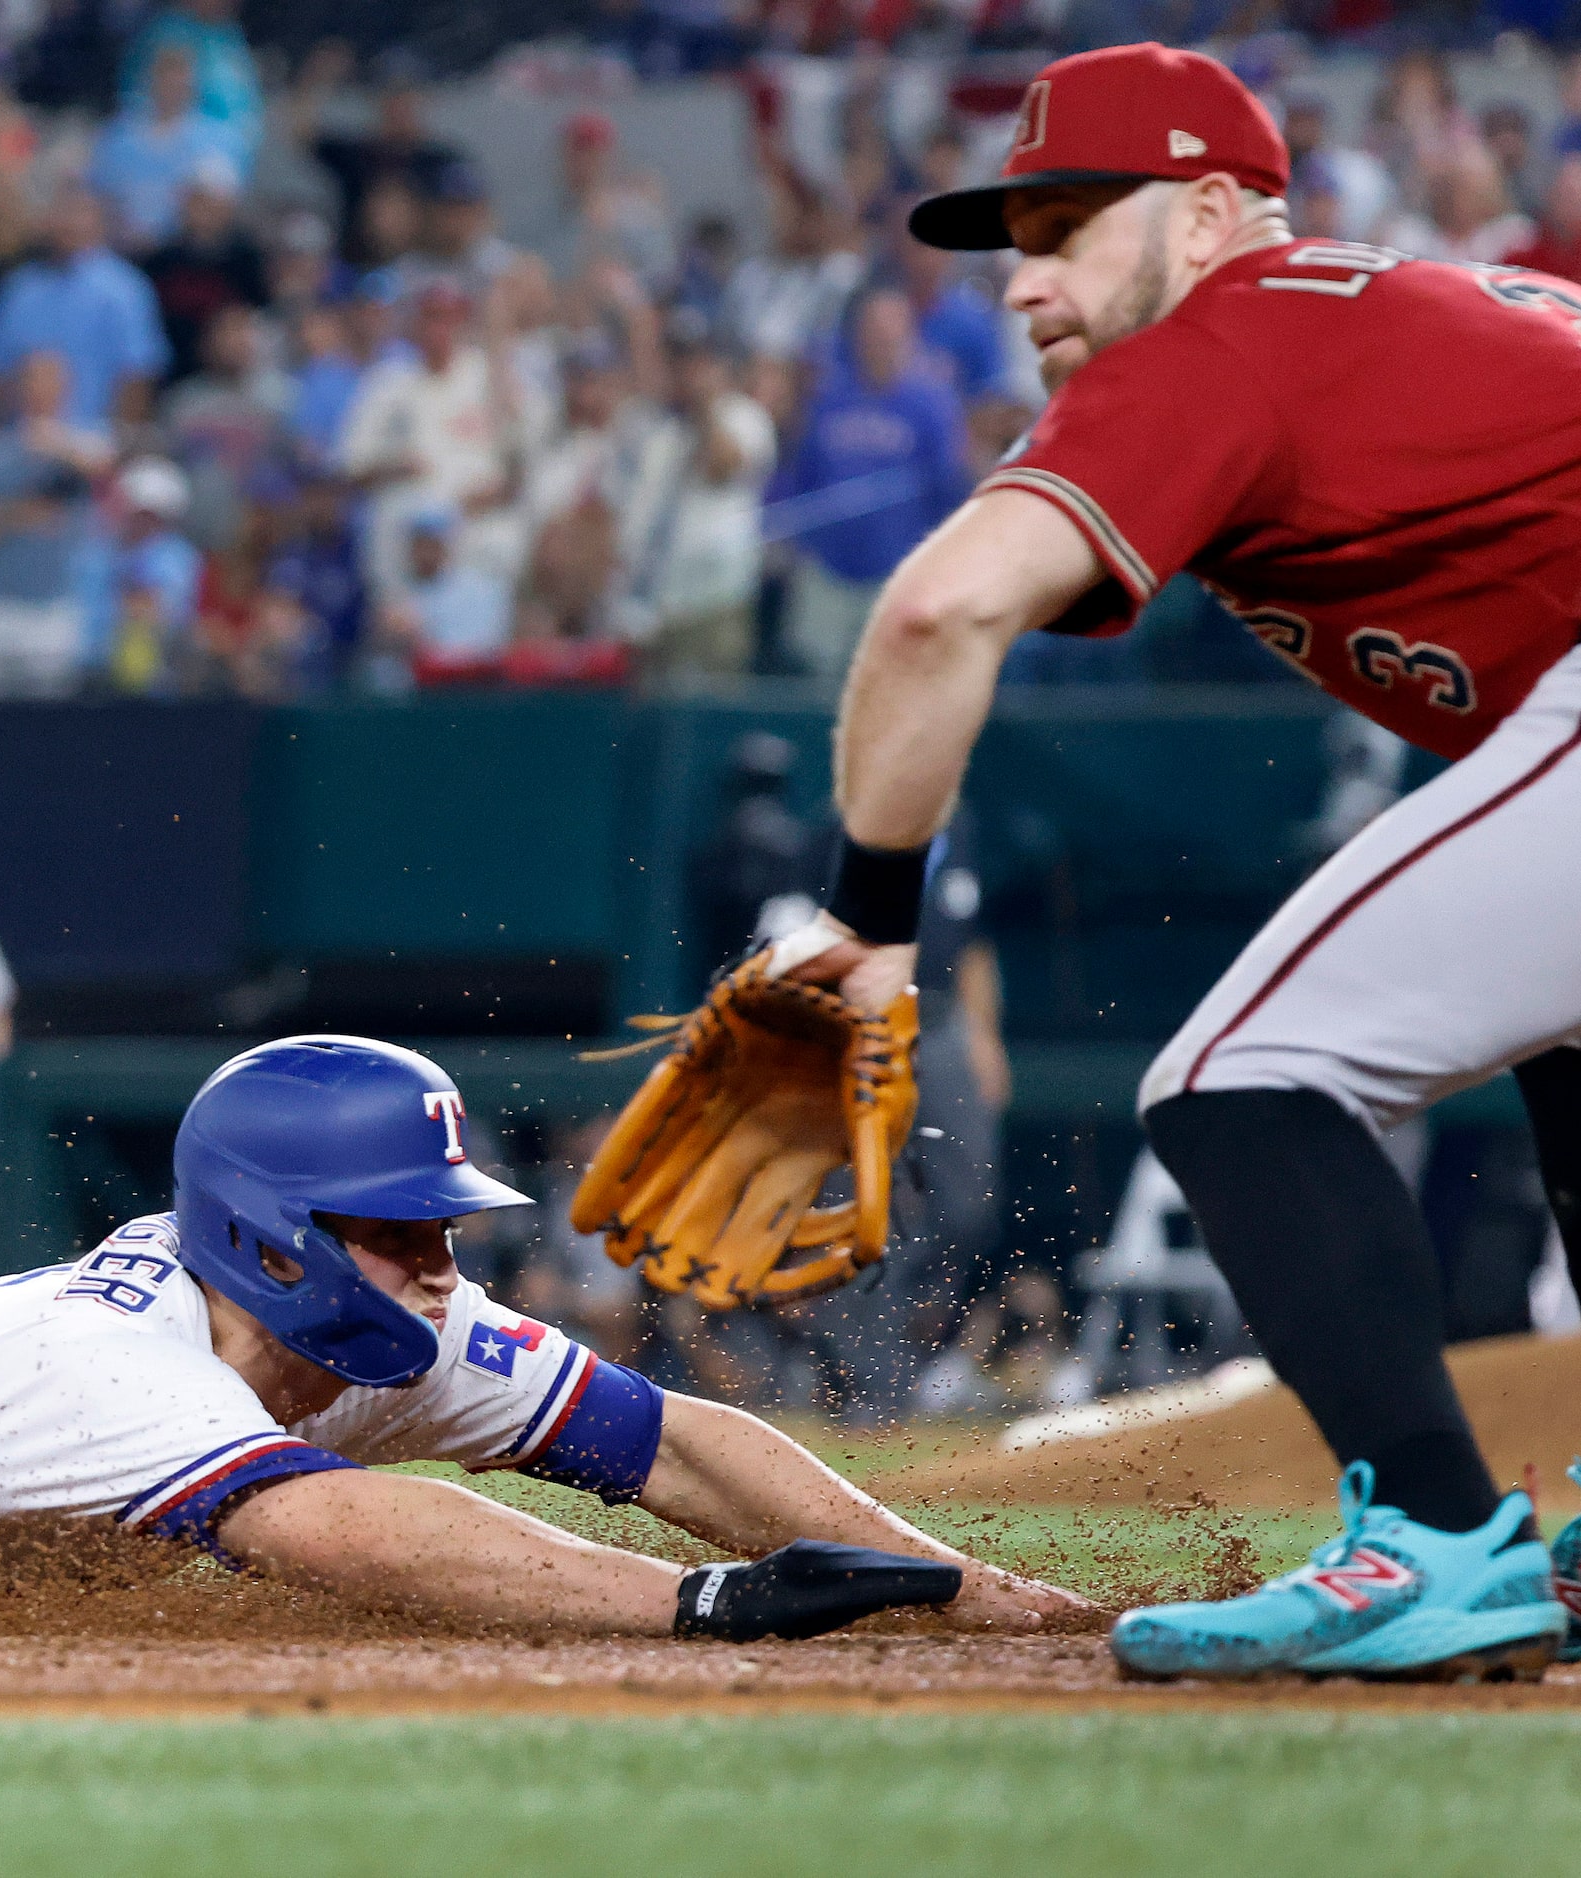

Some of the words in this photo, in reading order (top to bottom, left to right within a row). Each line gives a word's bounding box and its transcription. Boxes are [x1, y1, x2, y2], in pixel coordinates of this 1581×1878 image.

[1257, 240, 1412, 297] LO
[1346, 626, 1478, 714] 3
[423, 1090, 466, 1164] T
